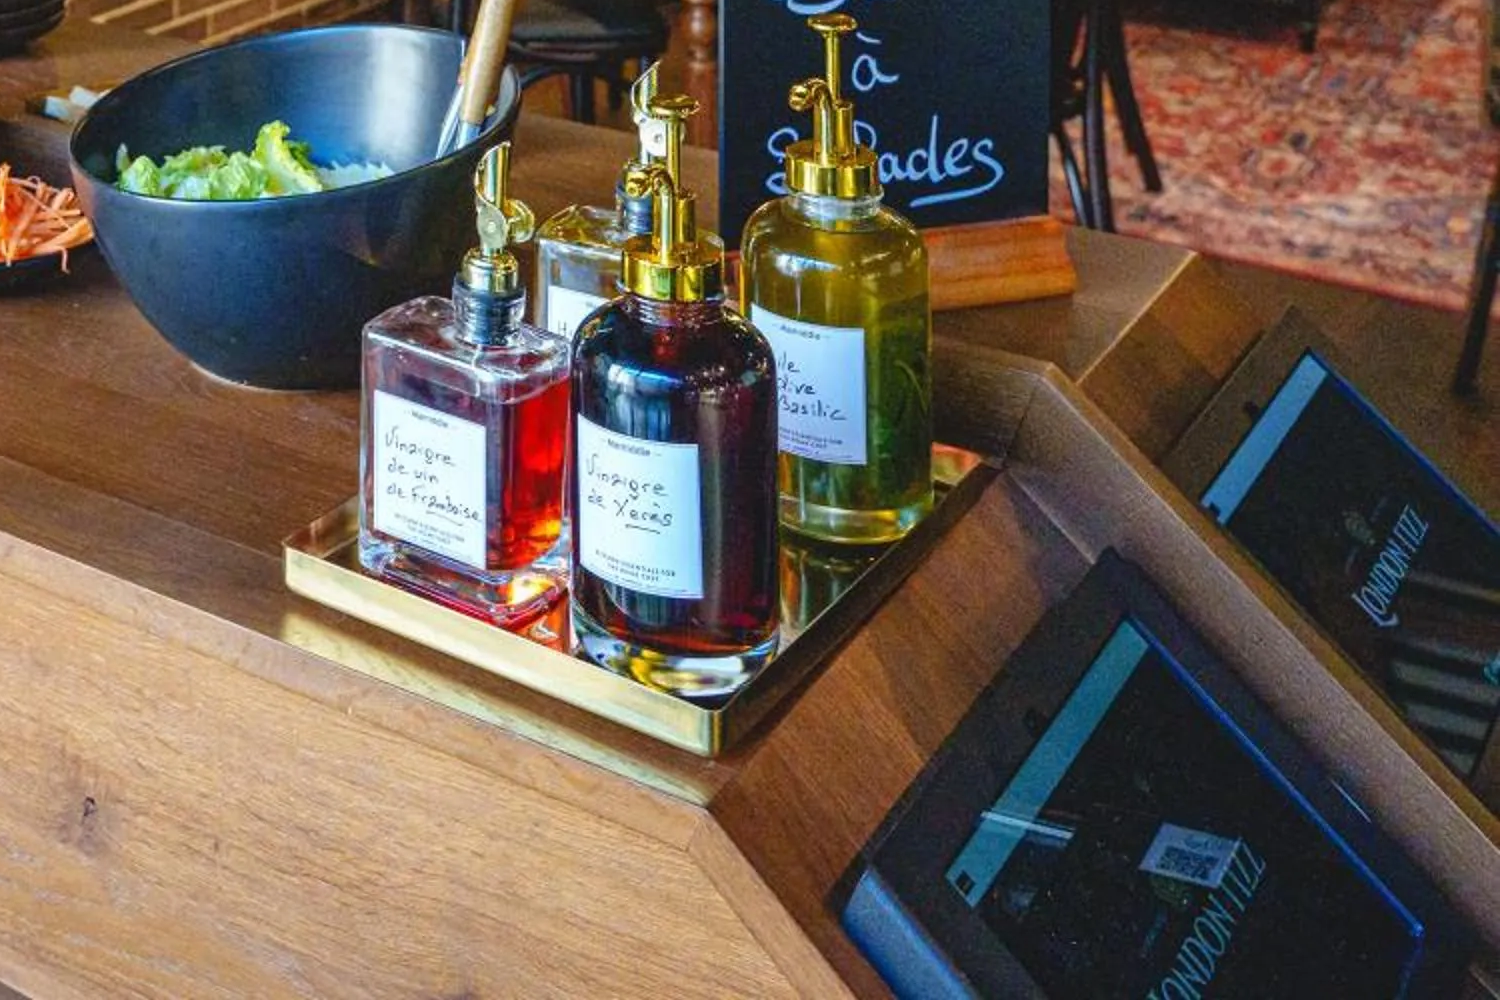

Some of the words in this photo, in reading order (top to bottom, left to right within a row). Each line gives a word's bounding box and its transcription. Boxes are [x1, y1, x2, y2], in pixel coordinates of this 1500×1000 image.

[851, 30, 899, 92] à
[765, 114, 1005, 208] Slades
[384, 424, 457, 467] Vinaigre
[387, 456, 410, 475] de
[585, 452, 669, 501] Vinaigre
[1351, 537, 1412, 627] LONDON
[1146, 892, 1238, 1000] ONDON
